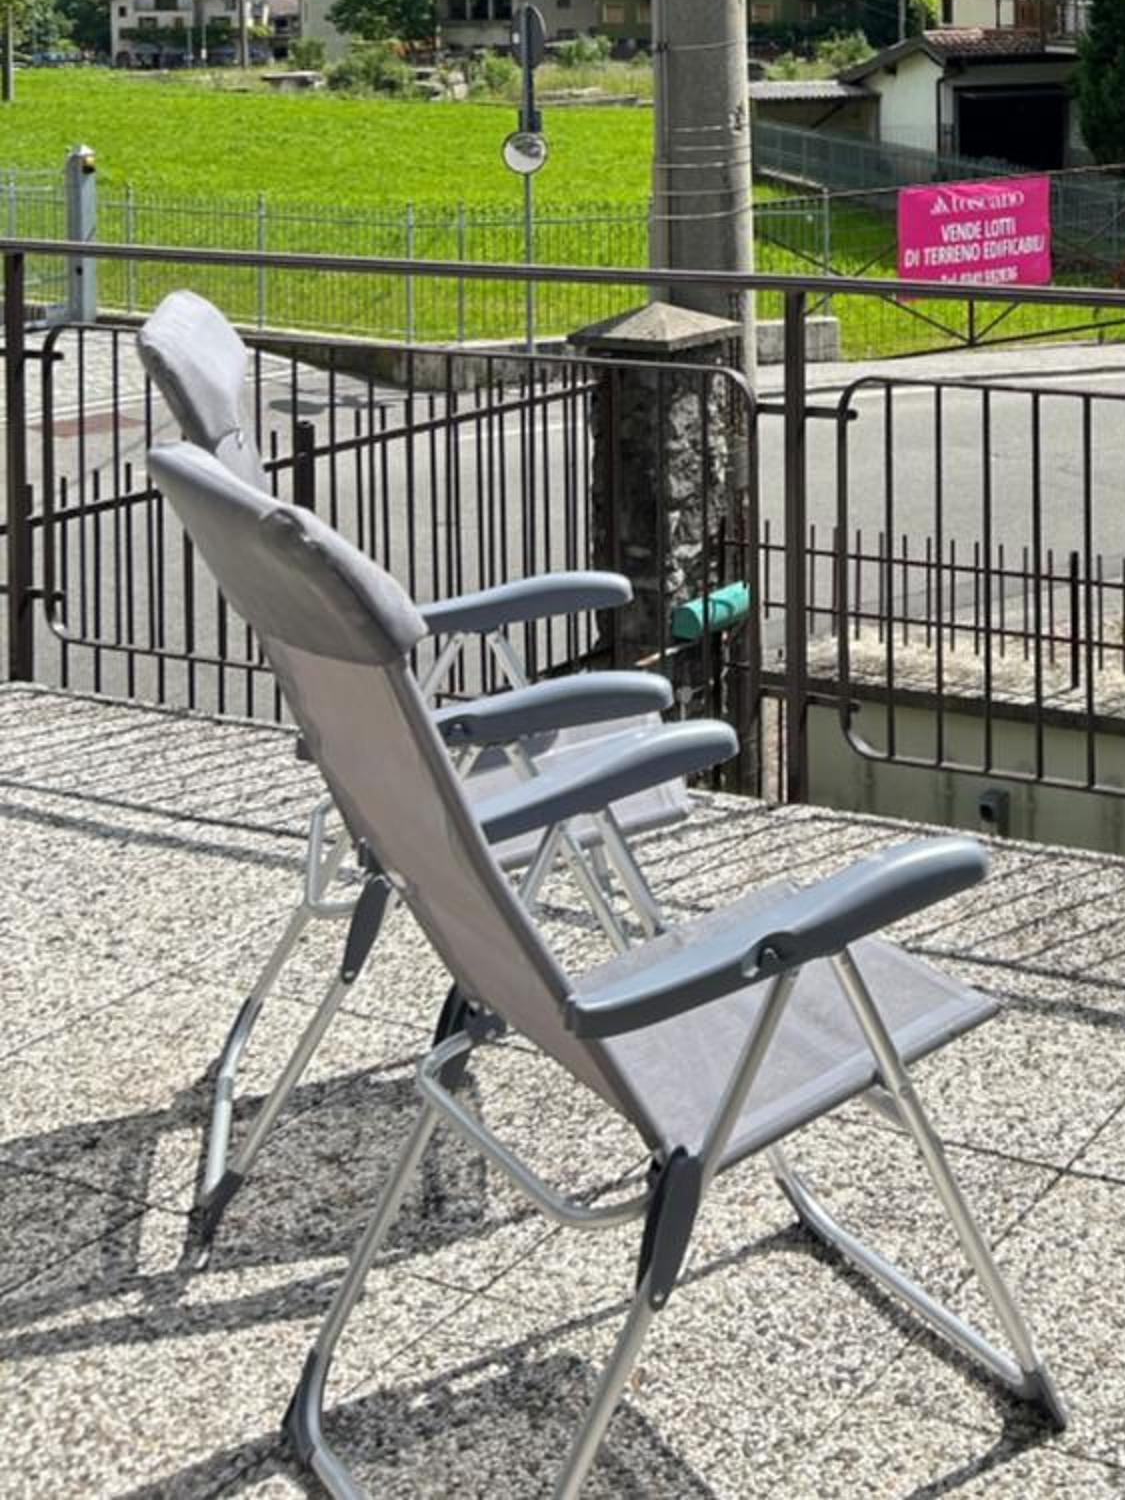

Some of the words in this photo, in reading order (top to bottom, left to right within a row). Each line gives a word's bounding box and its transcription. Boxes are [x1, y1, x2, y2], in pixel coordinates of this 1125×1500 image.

[941, 220, 982, 242] VENDE
[984, 217, 1016, 238] LOTTI
[904, 249, 919, 268] DI
[924, 243, 981, 266] TERRENO
[983, 235, 1045, 259] EDIFICABILI
